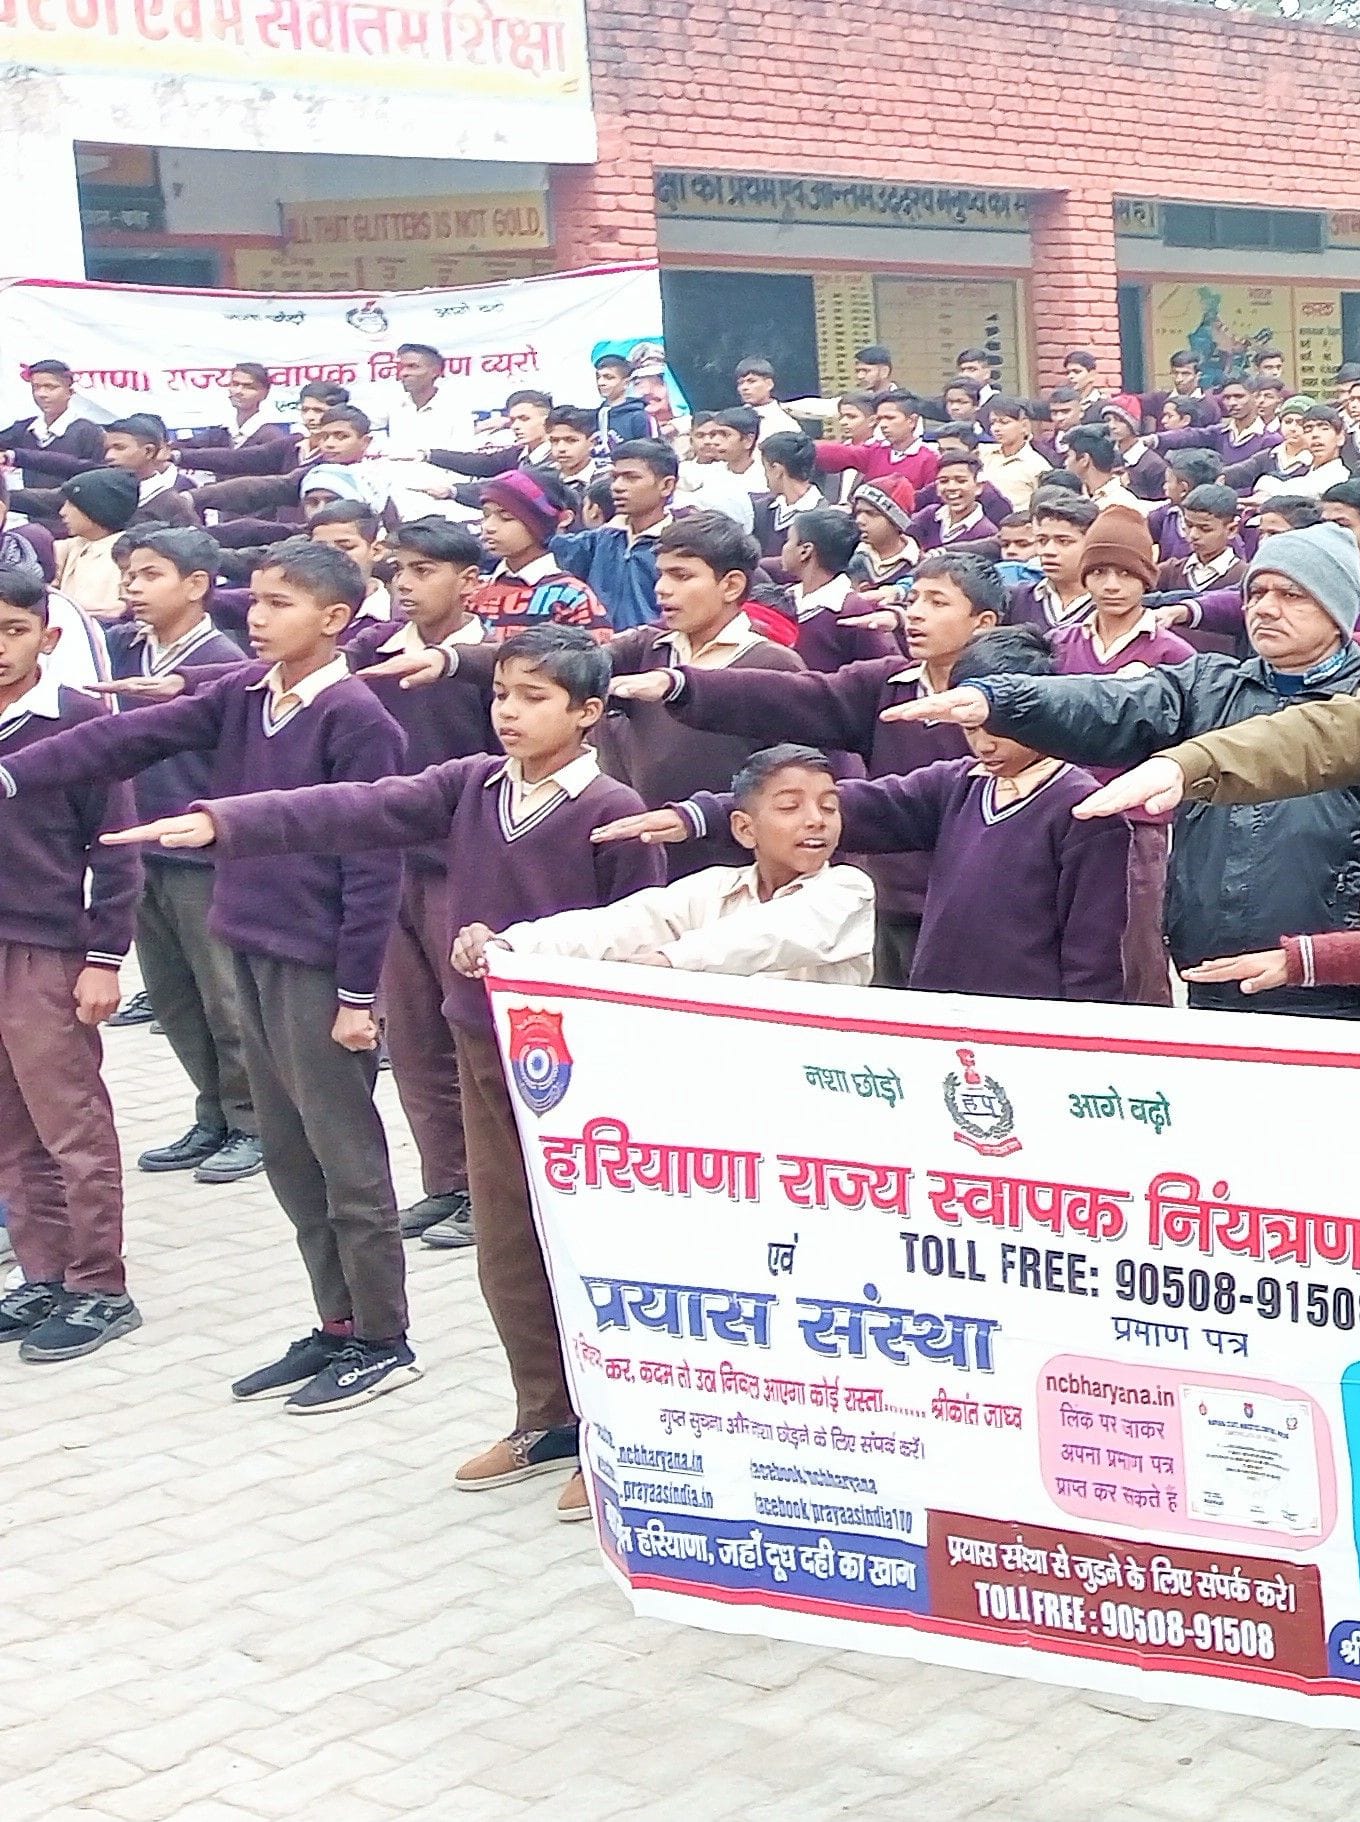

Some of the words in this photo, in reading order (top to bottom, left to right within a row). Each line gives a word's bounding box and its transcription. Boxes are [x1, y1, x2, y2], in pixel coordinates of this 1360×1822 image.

[802, 1064, 849, 1093] नशा
[1069, 1085, 1125, 1121] आगे
[538, 1116, 765, 1203] हरियाणा
[776, 1154, 914, 1219] राज्य
[926, 1168, 1134, 1241] स्वापक
[767, 1232, 800, 1277] एवं
[899, 1231, 987, 1283] TOLL
[1000, 1242, 1100, 1298] FREE:
[579, 1274, 779, 1350] प्रयास
[795, 1282, 1002, 1375] संस्था
[1110, 1316, 1190, 1350] प्रमाण
[1201, 1328, 1249, 1358] पत्र
[1045, 1372, 1176, 1408] ncbharyana.in
[1100, 1413, 1118, 1433] पर
[1061, 1443, 1102, 1466] अपना
[1150, 1455, 1176, 1476] पत्र
[1055, 1476, 1088, 1498] प्राप्त
[1092, 1481, 1118, 1502] कर
[634, 1518, 716, 1566] हरियाणा,
[798, 1535, 836, 1580] दही
[837, 1550, 867, 1581] का
[946, 1535, 998, 1568] प्रयास
[999, 1535, 1049, 1577] संस्था
[1050, 1543, 1071, 1577] से
[1124, 1556, 1147, 1592] के
[1149, 1555, 1196, 1598] लिए
[1196, 1564, 1252, 1605] संपर्क
[974, 1581, 1032, 1624] TOLL
[1100, 1600, 1276, 1661] 90508-91508
